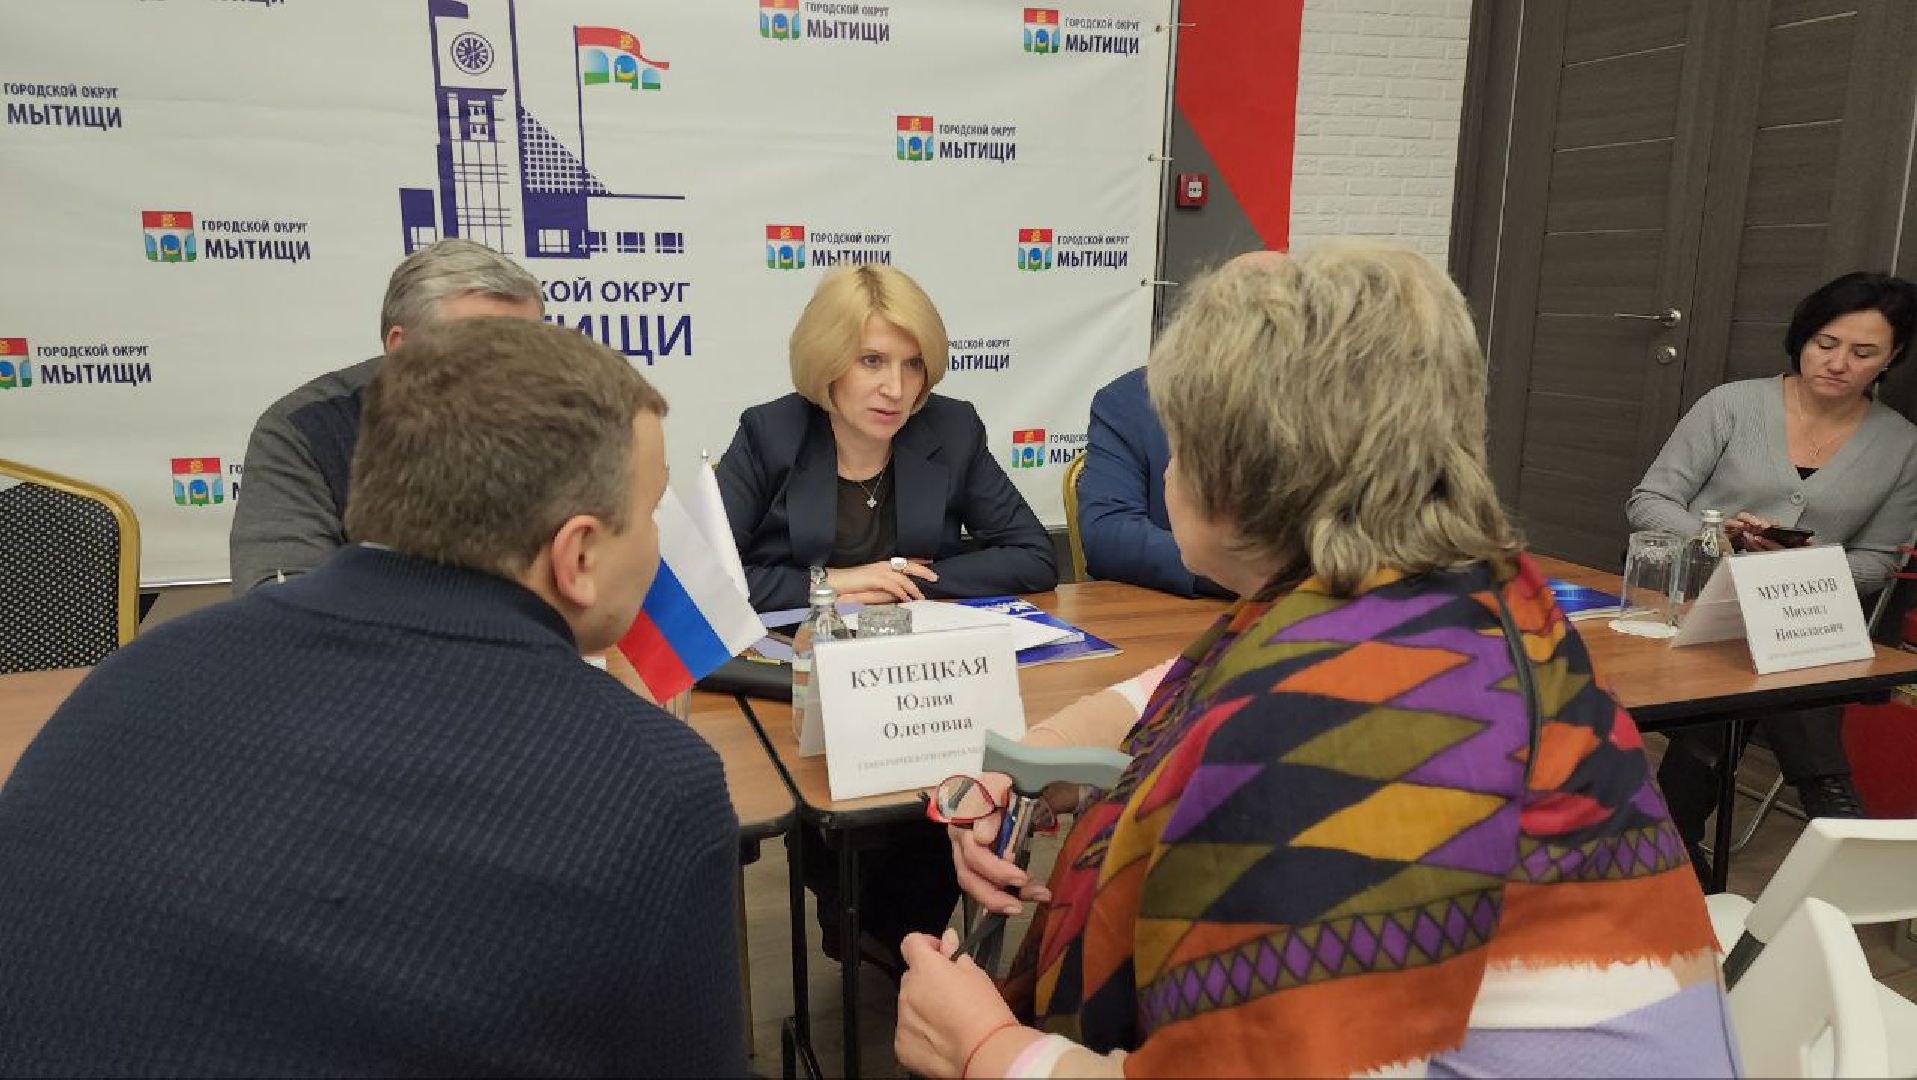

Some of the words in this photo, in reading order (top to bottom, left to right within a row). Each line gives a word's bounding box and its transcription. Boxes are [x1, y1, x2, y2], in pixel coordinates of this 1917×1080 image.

[805, 2, 859, 15] ГОРОДСКОЙ
[861, 6, 889, 16] ОКРУГ
[807, 19, 890, 43] МЫТИЩИ
[1065, 17, 1112, 30] ГОРОДСКОЙ
[1065, 34, 1139, 57] МЫТИЩИ
[4, 82, 77, 98] ГОРОДСКОЙ
[81, 85, 119, 98] ОКРУГ
[8, 103, 122, 131] МЫТИЩИ
[940, 124, 988, 137] ГОРОДСКОЙ
[991, 126, 1016, 136] ОКРУГ
[940, 142, 1016, 163] МЫТИЩИ
[202, 220, 269, 233] ГОРОДСКОЙ
[273, 222, 308, 234] ОКРУГ
[811, 232, 861, 244] ГОРОДСКОЙ
[864, 234, 891, 244] ОКРУГ
[1057, 235, 1103, 246] ГОРОДСКОЙ
[205, 239, 311, 263] МЫТИЩИ
[1057, 250, 1128, 269] МЫТИЩИ
[601, 281, 691, 303] ОКРУГ
[37, 344, 110, 358] ГОРОДСКОЙ
[112, 345, 149, 357] ОКРУГ
[947, 354, 1010, 372] ЫТИЩИ
[41, 363, 152, 387] МЫТИЩИ
[1758, 578, 1837, 598] МУРЗАКОВ
[852, 657, 988, 688] КУПЕЦКАЯ
[897, 693, 953, 711] Юлия
[884, 717, 972, 739] Олеговна
